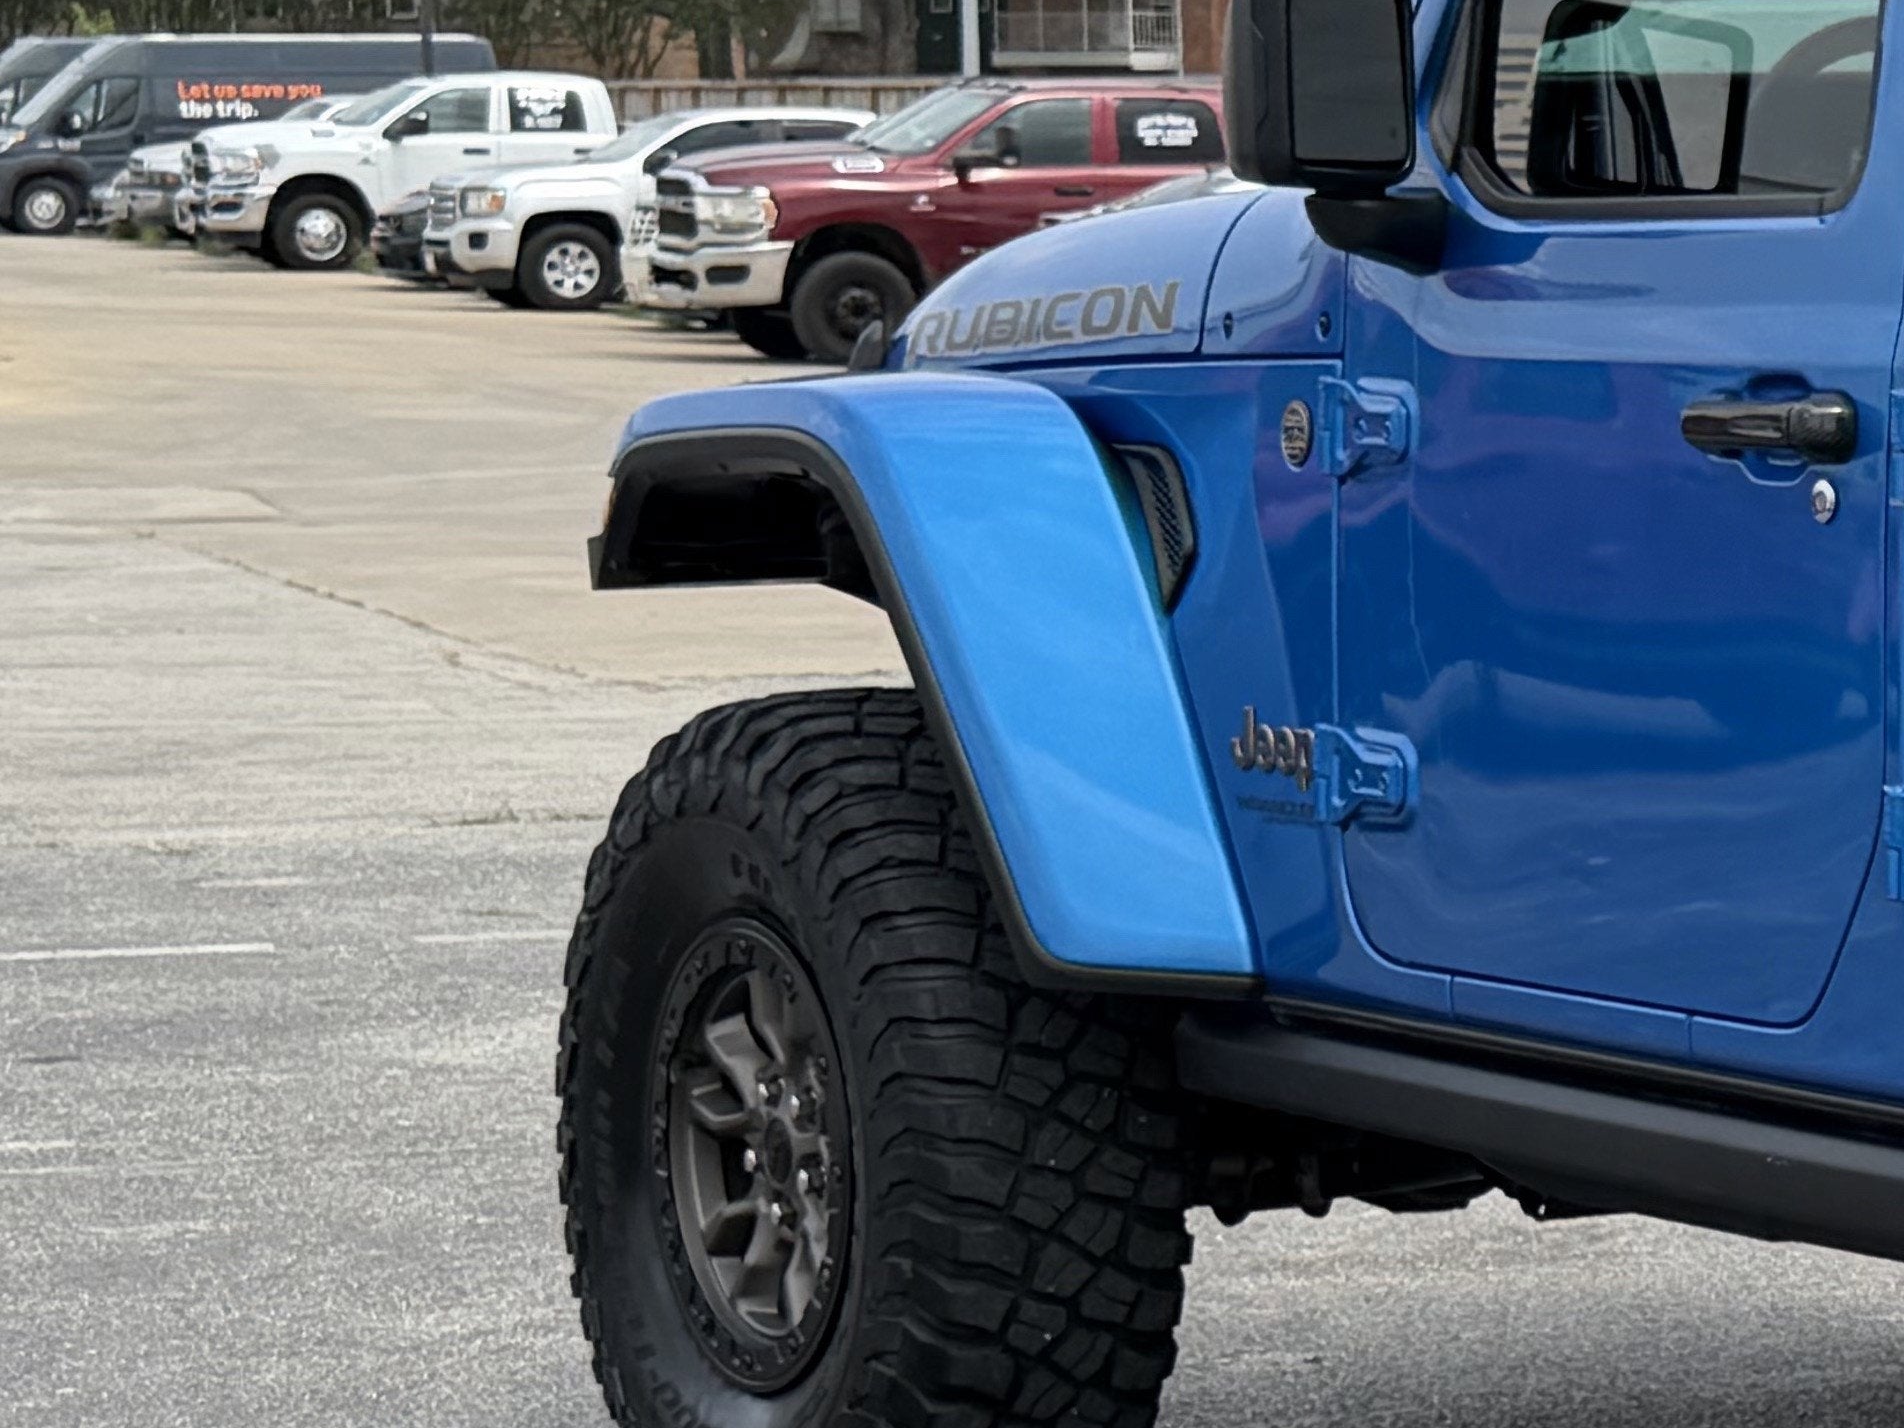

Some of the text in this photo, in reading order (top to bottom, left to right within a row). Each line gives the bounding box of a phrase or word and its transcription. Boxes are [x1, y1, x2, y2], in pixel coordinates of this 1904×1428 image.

[177, 80, 323, 102] Let us save you
[179, 99, 260, 121] the trip.
[907, 278, 1182, 356] RUBICON
[1231, 705, 1316, 793] Jeep
